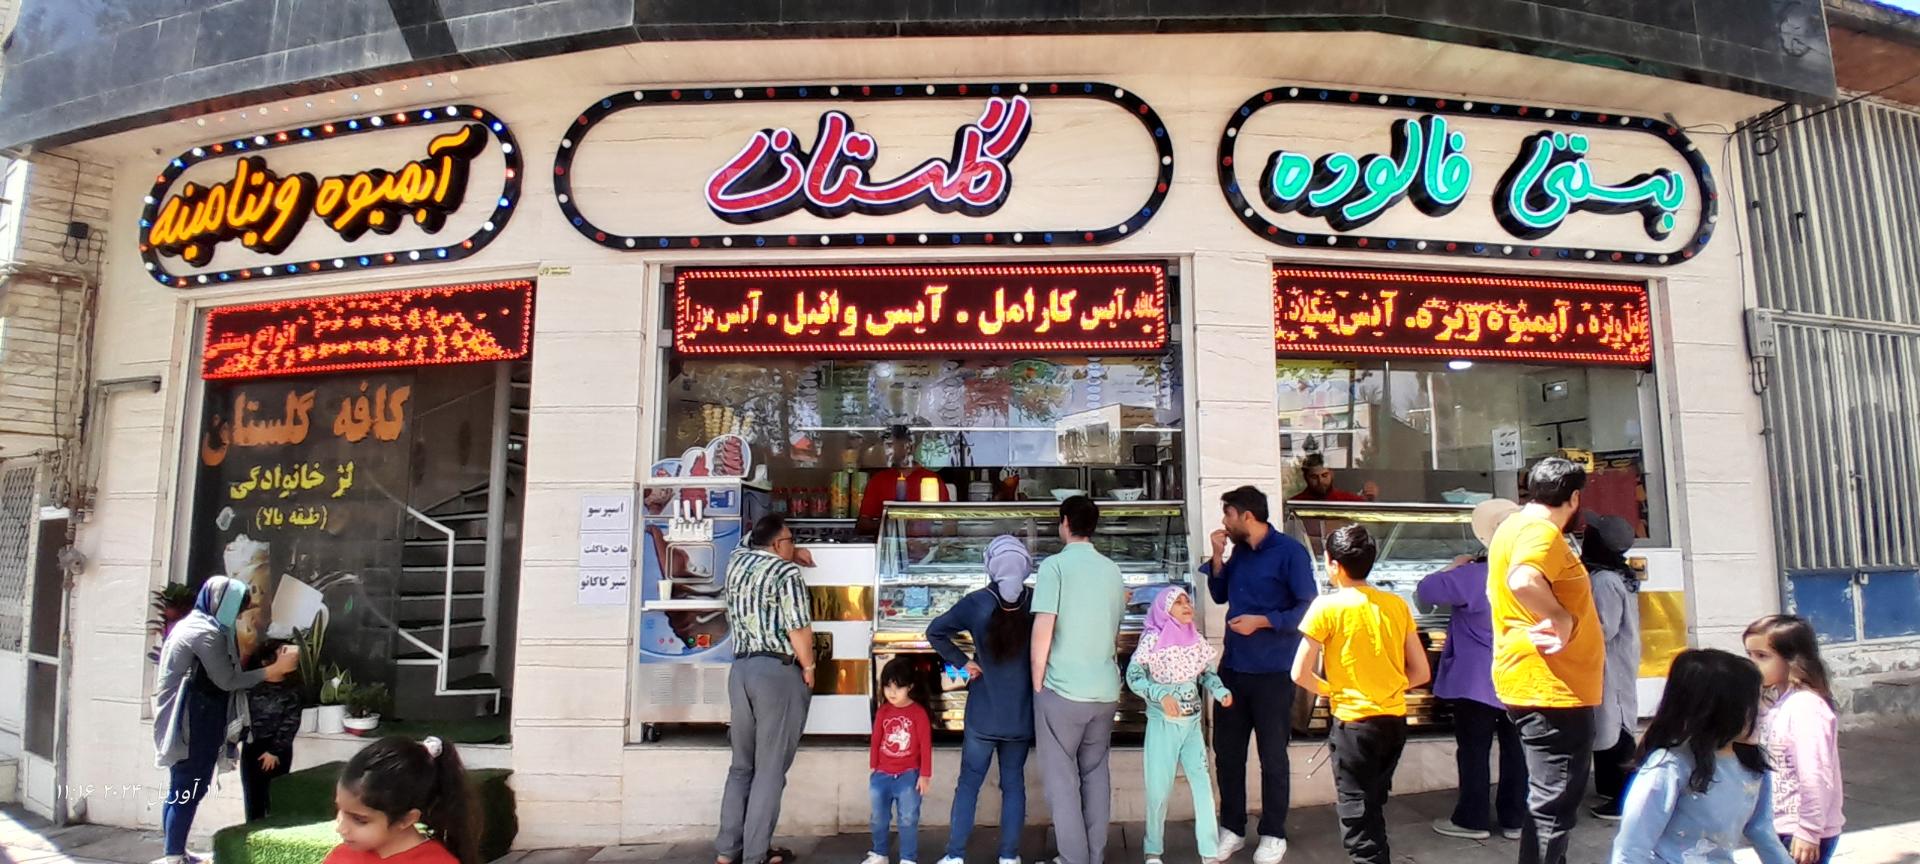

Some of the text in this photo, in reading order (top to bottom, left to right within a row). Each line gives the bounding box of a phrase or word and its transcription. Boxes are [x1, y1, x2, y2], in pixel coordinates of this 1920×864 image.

[150, 126, 471, 262] آبمیوه ویتامینه
[704, 95, 1031, 217] گلستان
[1270, 114, 1686, 231] بستنی فالوده
[202, 381, 411, 467] کافه گلستان
[230, 460, 355, 500] لژ خانوادگی
[587, 501, 625, 518] اسپرسو
[609, 575, 628, 590] شیر
